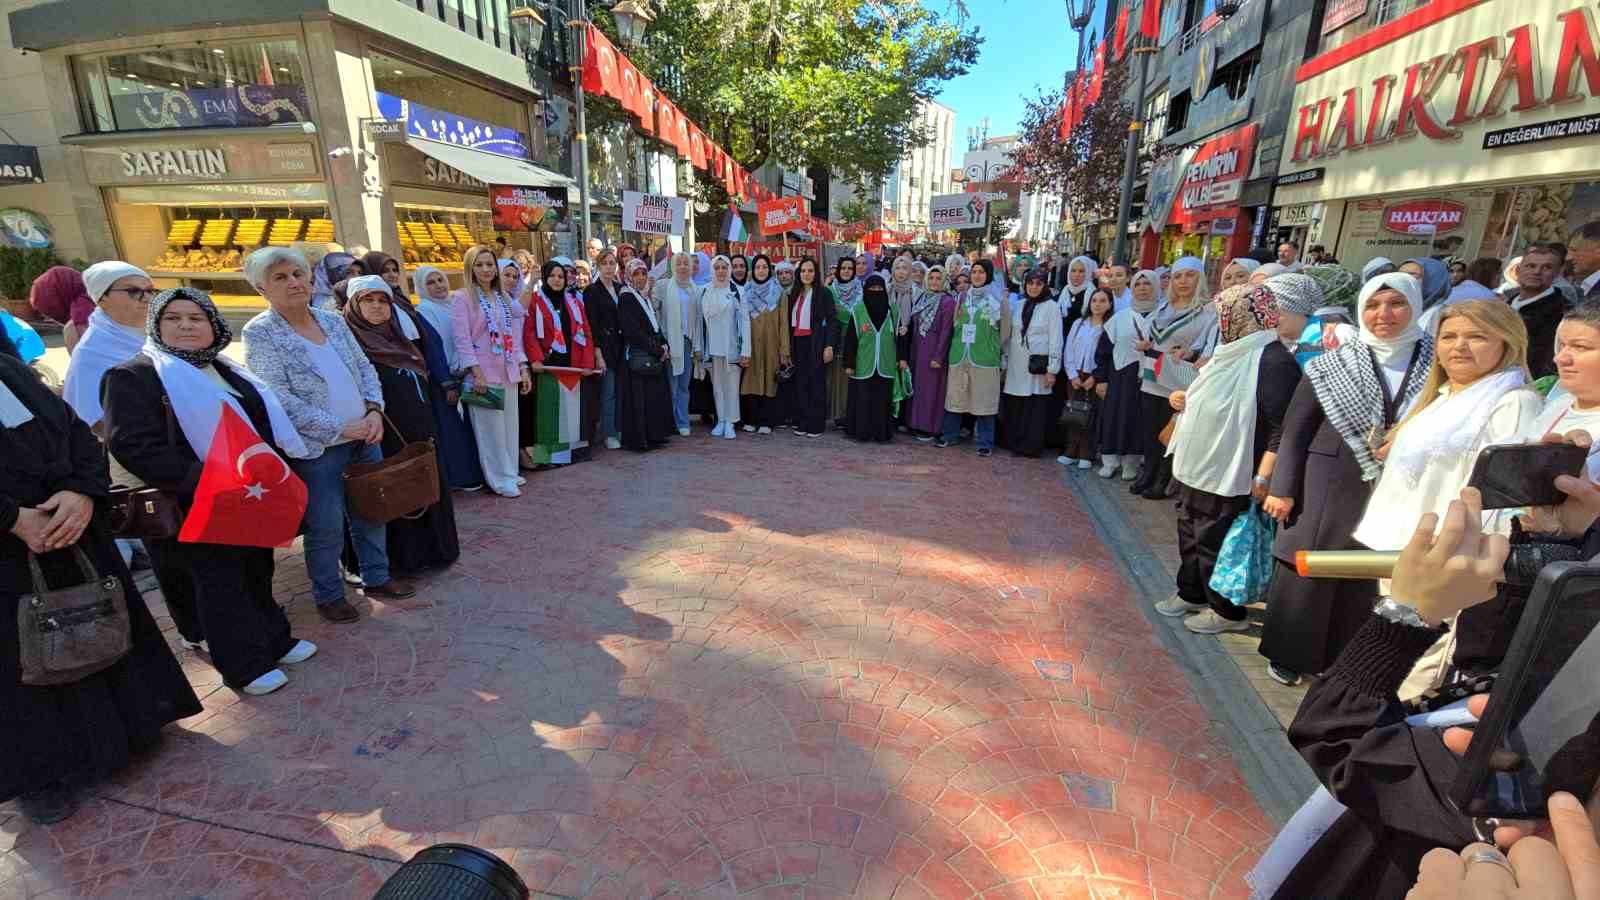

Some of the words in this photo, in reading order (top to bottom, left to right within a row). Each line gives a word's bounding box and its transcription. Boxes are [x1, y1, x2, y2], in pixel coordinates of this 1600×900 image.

[1487, 134, 1501, 146] EN
[1503, 121, 1567, 144] DEĞERLİMİZ
[120, 149, 229, 177] SAFALTIN
[0, 164, 33, 177] ASI
[933, 208, 964, 218] FREE
[1390, 211, 1461, 223] HALKTAN
[635, 219, 672, 235] MÜMKÜN
